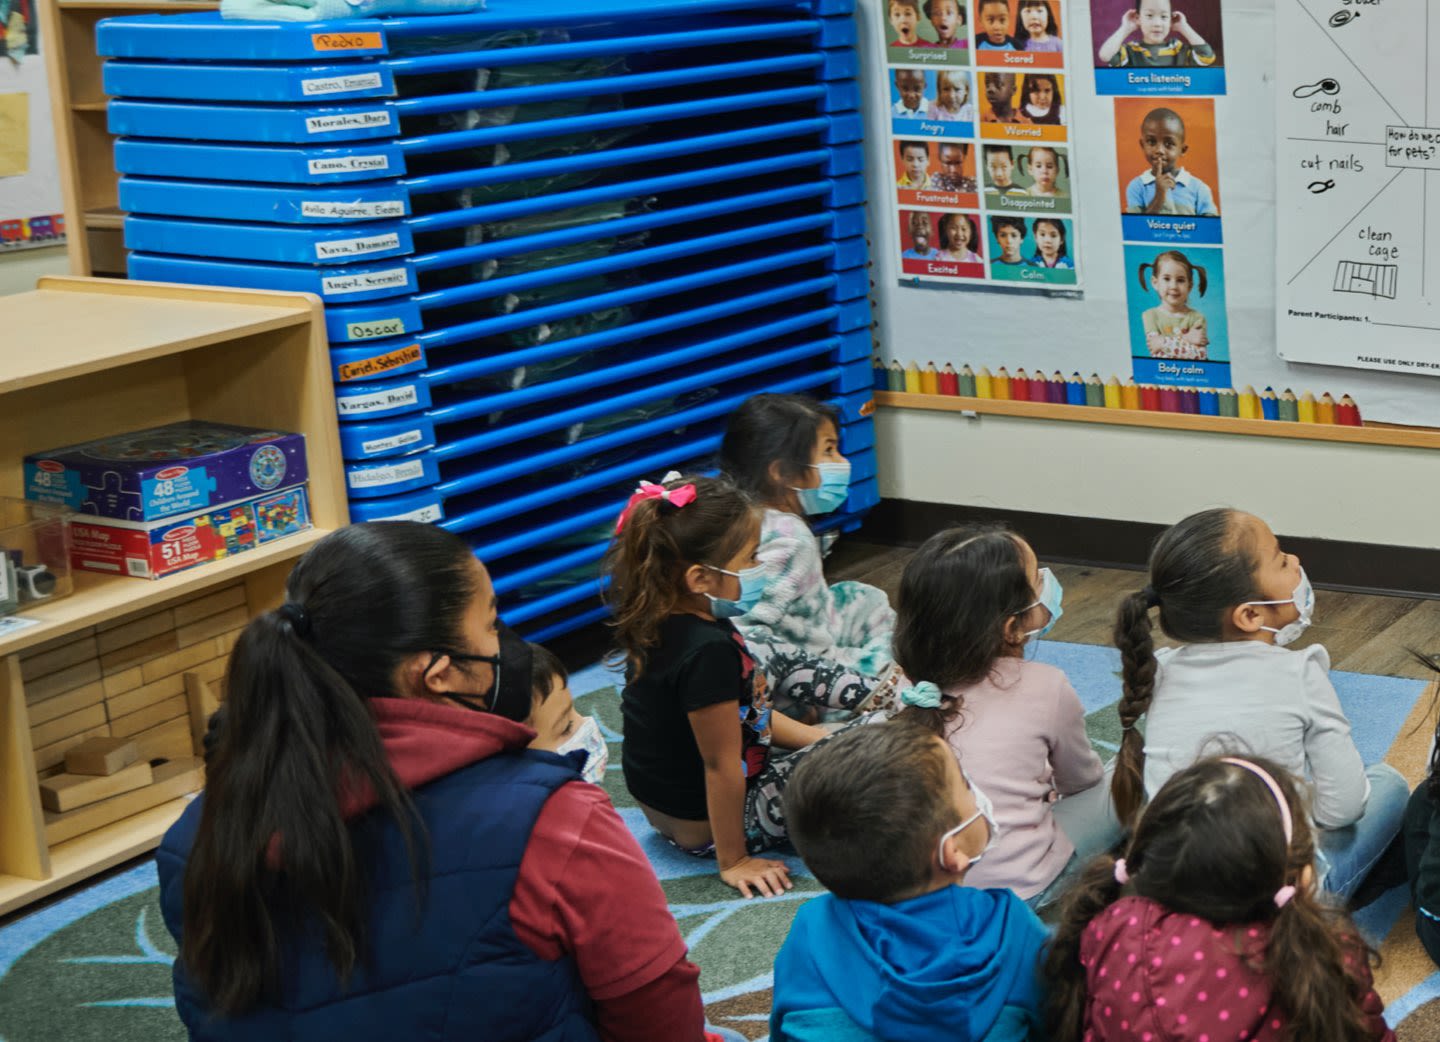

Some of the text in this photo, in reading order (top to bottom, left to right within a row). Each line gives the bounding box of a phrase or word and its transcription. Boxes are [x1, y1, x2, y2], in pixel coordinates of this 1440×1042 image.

[317, 35, 364, 47] Pedro
[908, 49, 947, 62] Surprised
[1004, 53, 1034, 64] Scared
[1128, 72, 1191, 86] Ears listening
[1311, 99, 1342, 114] comb
[920, 122, 945, 135] Angry
[1005, 126, 1041, 137] Worried
[1326, 120, 1350, 136] hair
[1388, 129, 1405, 141] How
[1408, 129, 1419, 141] do
[1421, 132, 1434, 144] we
[1388, 146, 1436, 160] for pets?
[1301, 154, 1364, 173] cut nails
[916, 192, 959, 204] Frustrated
[1001, 196, 1055, 210] Disappointed
[1146, 219, 1196, 234] Voice quiet
[1358, 227, 1392, 241] clean
[1369, 244, 1399, 261] cage
[928, 264, 958, 275] Excited
[1021, 269, 1045, 280] Calm
[1288, 309, 1313, 318] Parent
[1315, 311, 1363, 323] Participants:
[352, 324, 399, 338] Oscar
[1357, 355, 1381, 364] PLEASE
[1383, 358, 1397, 366] USE
[1398, 359, 1415, 367] ONLY
[1158, 362, 1204, 376] Body calm
[34, 471, 51, 487] 48
[153, 480, 174, 497] 48
[161, 541, 181, 559] 51
